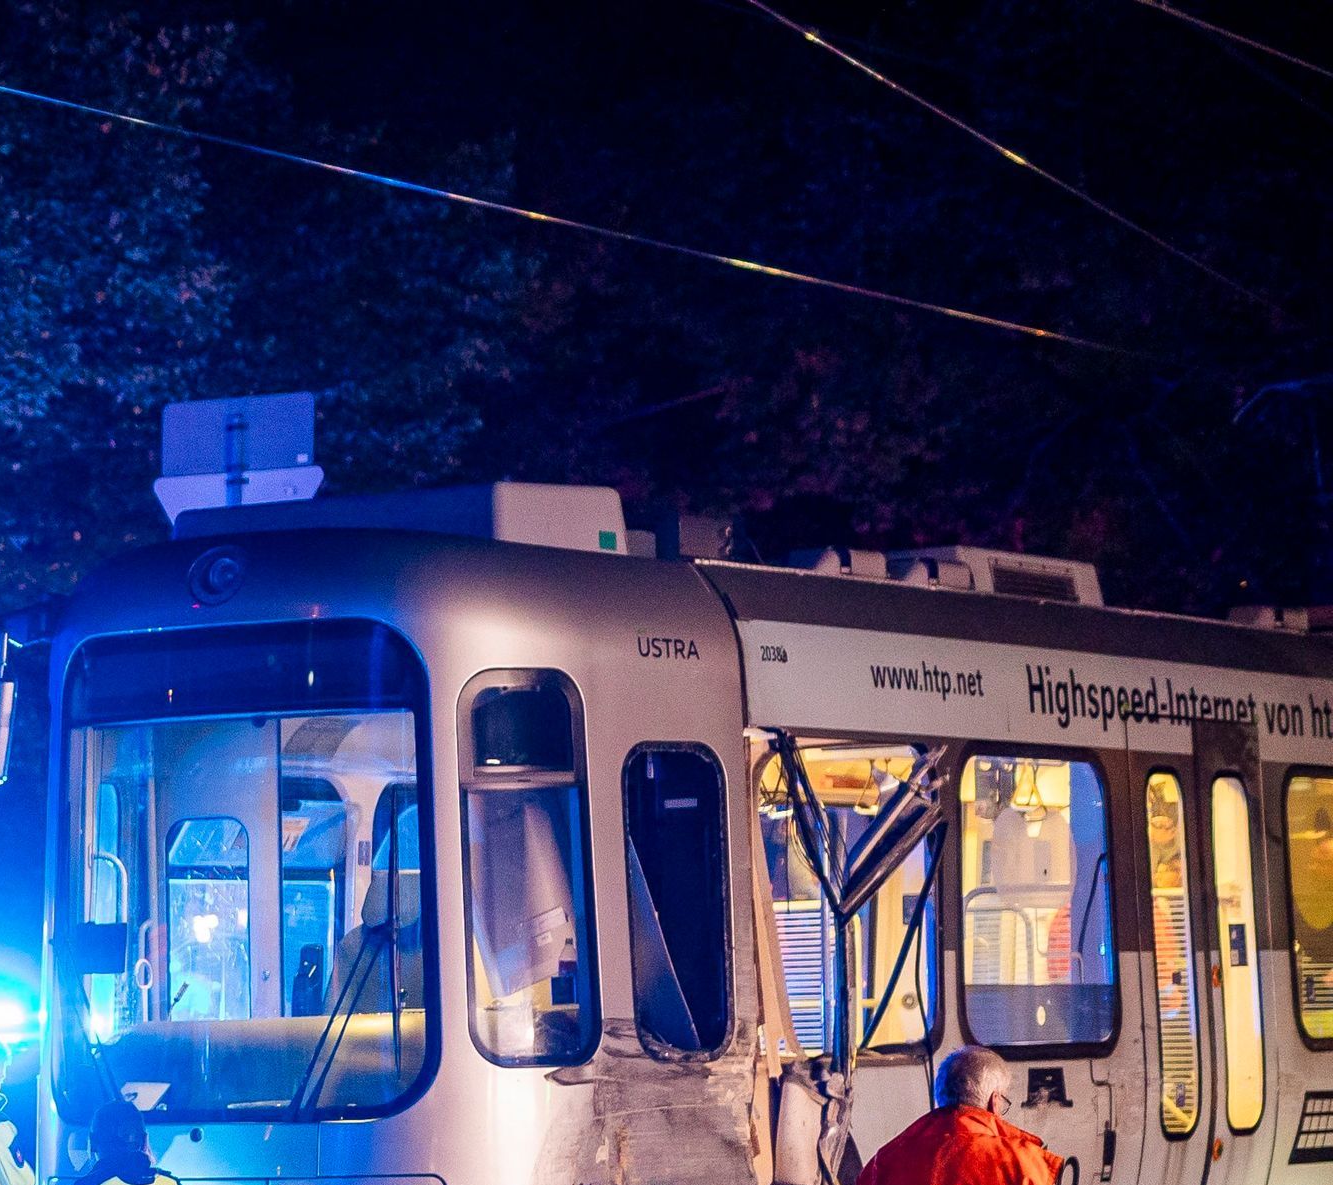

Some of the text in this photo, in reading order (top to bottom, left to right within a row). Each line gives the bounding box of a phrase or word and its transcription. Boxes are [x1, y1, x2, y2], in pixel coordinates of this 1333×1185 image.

[870, 661, 984, 701] www.htp.net
[1025, 663, 1257, 731] Highspeed-Internet
[1264, 701, 1304, 737] von
